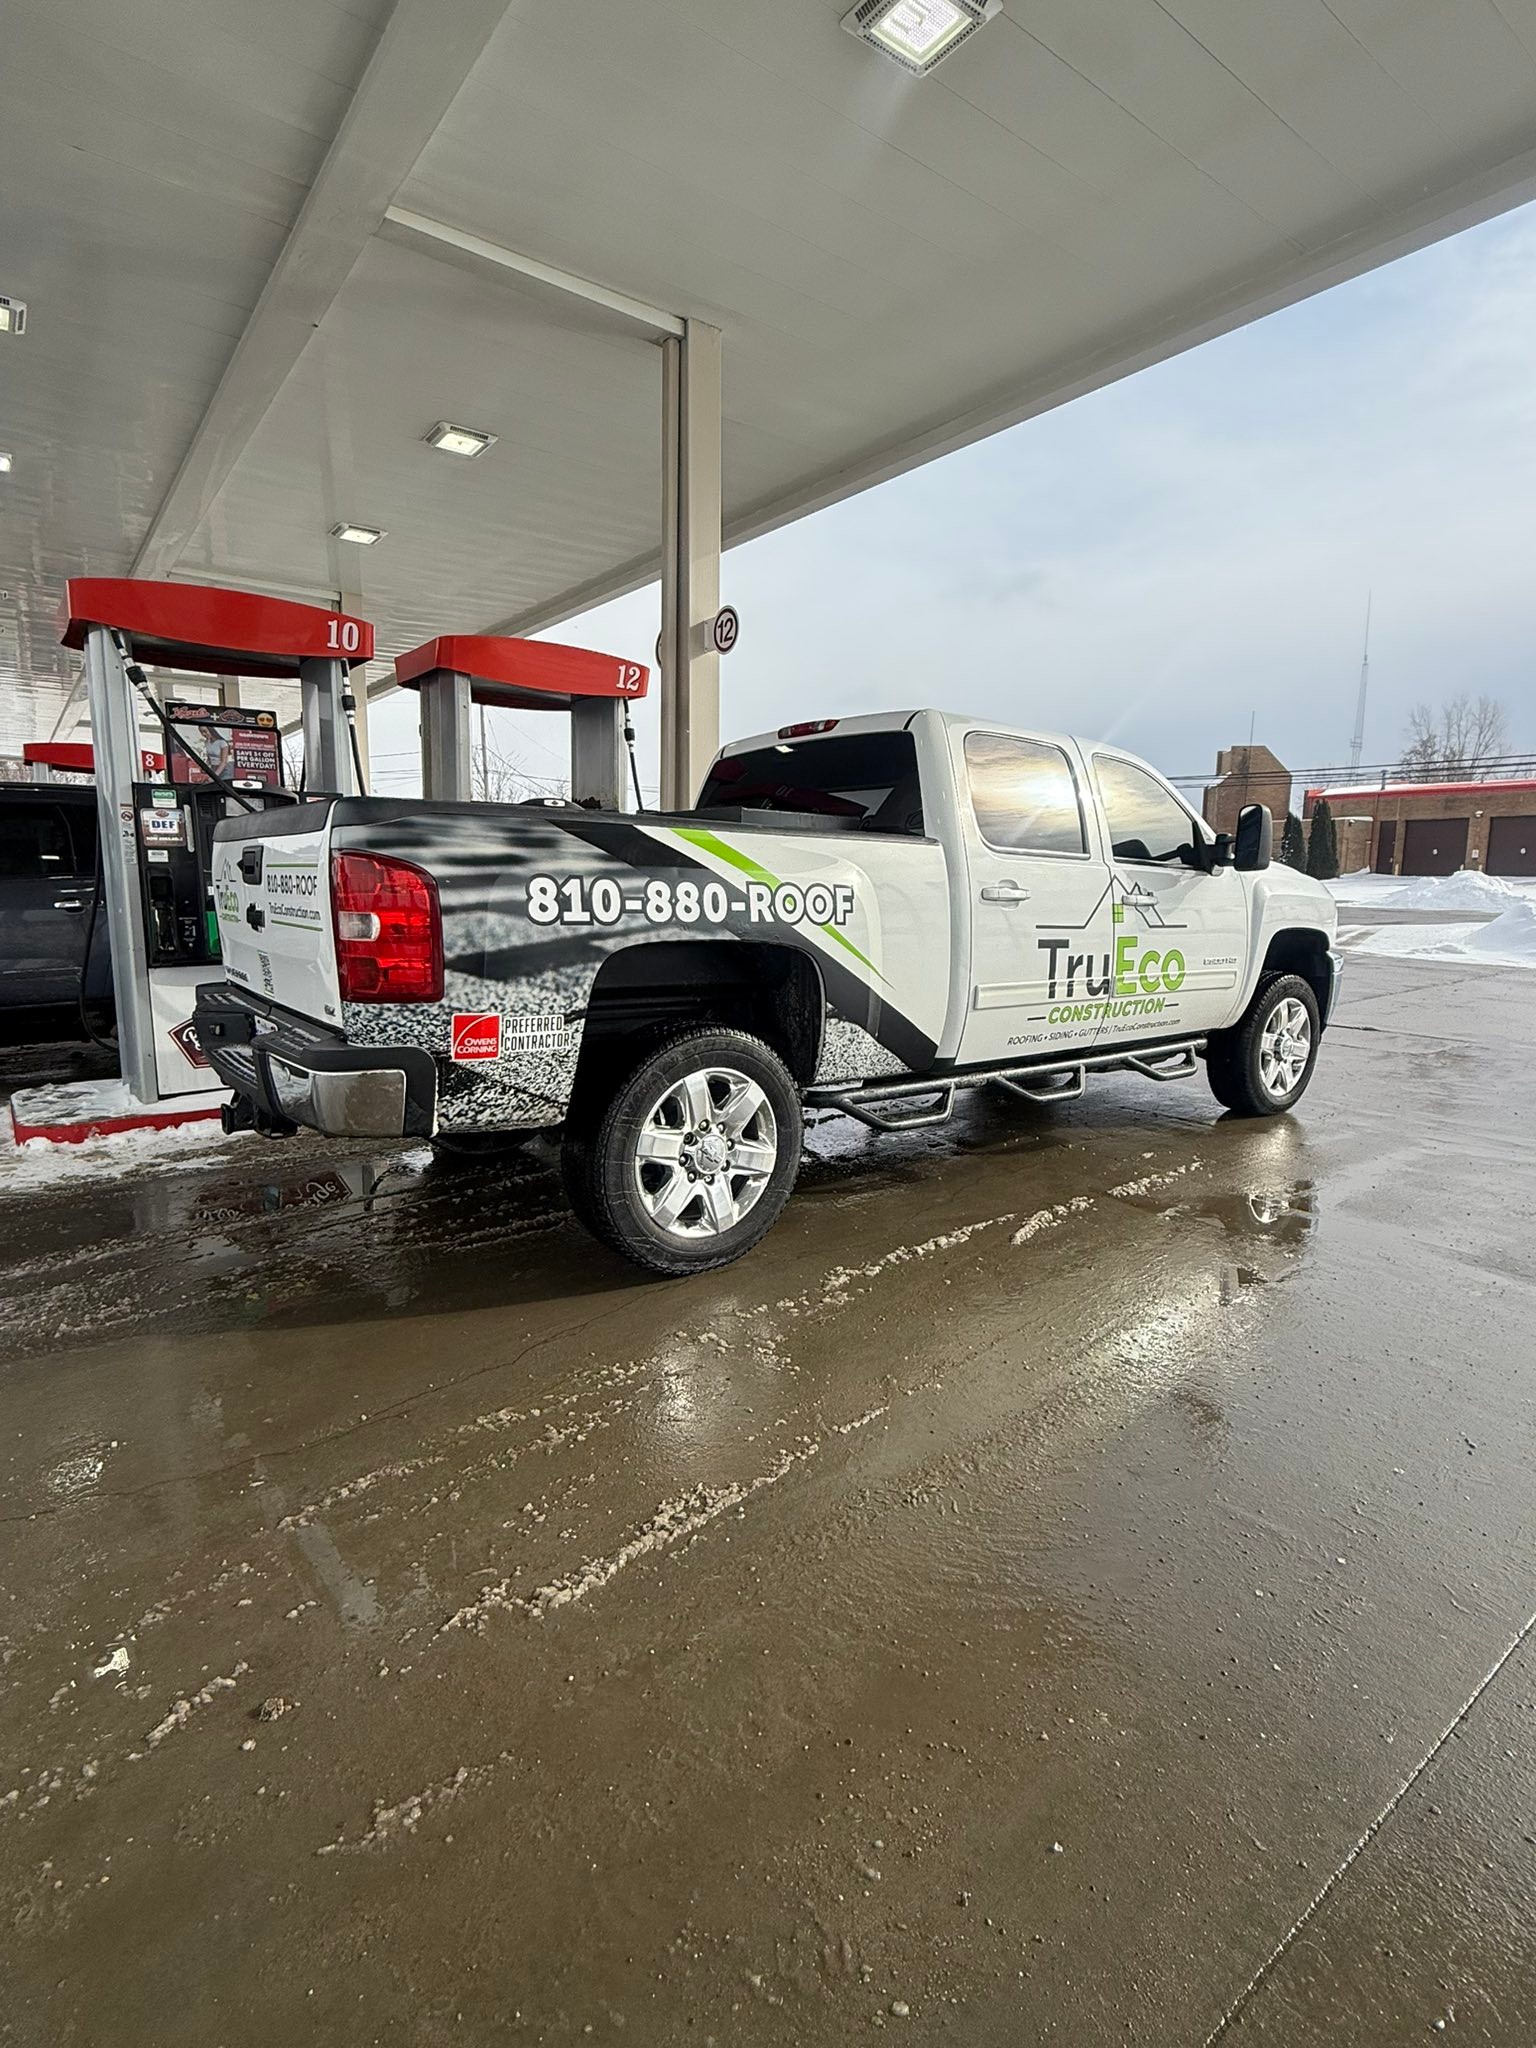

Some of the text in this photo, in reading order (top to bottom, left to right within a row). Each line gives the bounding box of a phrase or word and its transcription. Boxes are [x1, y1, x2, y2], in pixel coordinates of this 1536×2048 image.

[327, 619, 359, 651] 10
[717, 617, 734, 643] 12
[616, 664, 641, 692] 12
[145, 753, 155, 767] 8
[237, 761, 277, 770] EVERYDAY!
[249, 756, 276, 764] GALLON
[151, 820, 176, 829] DEF
[266, 874, 317, 896] 810-880-ROOF
[525, 873, 855, 926] 810-880-ROOF
[1038, 936, 1185, 999] TruEco
[1048, 997, 1166, 1025] CONSTRUCTION
[504, 1016, 563, 1034] PREFERRED
[1007, 1019, 1181, 1046] ROOFING SIDING GUTTERS TruEcoConstruction.com
[457, 1045, 498, 1054] CORNING
[464, 1037, 498, 1046] OWENS
[504, 1033, 570, 1051] CONTRACTOR
